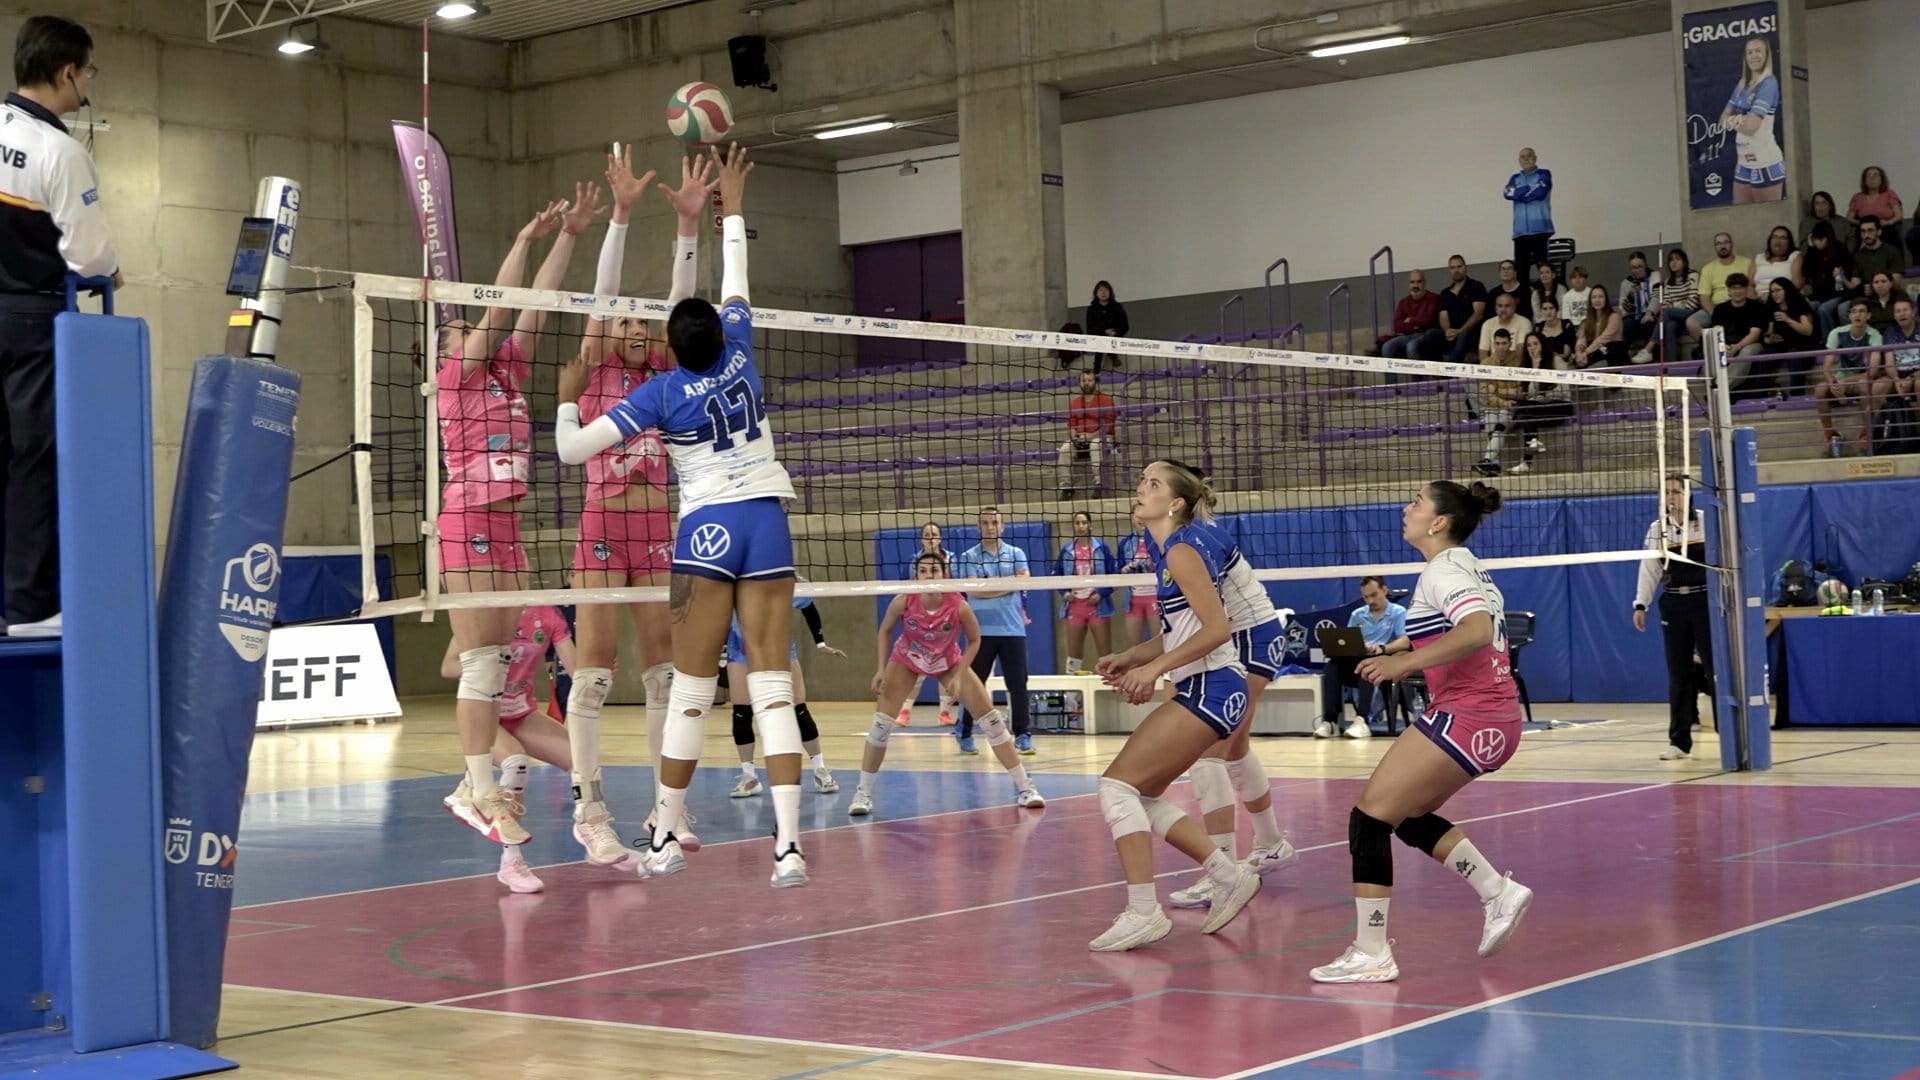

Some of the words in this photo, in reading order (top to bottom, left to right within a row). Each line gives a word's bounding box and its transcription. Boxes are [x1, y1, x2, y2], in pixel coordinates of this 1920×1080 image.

[1684, 14, 1777, 49] ¡GRACIAS!
[0, 144, 27, 169] VB
[486, 289, 503, 299] CEV
[704, 376, 762, 453] 17
[258, 655, 361, 701] EFF
